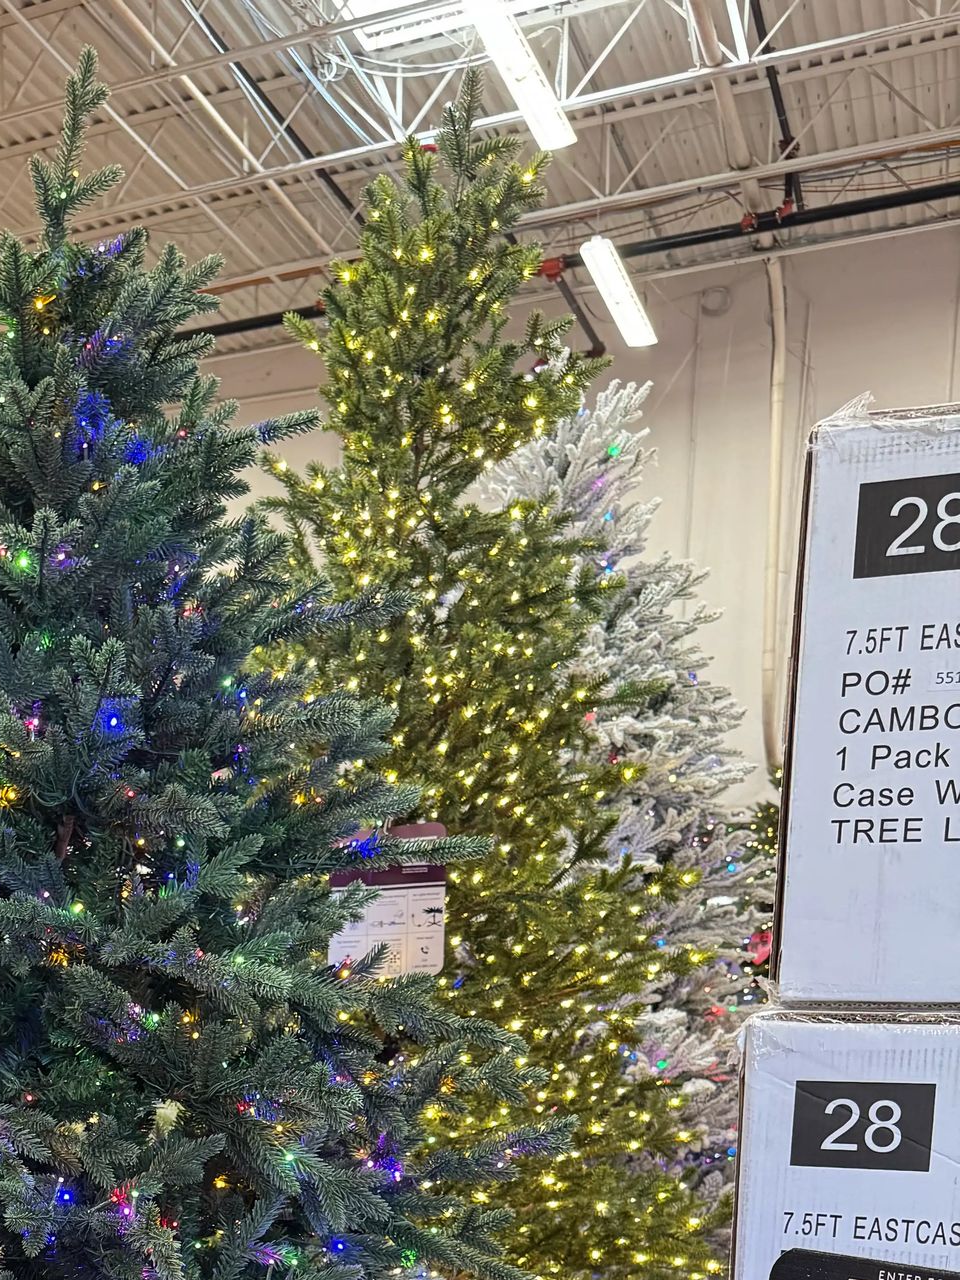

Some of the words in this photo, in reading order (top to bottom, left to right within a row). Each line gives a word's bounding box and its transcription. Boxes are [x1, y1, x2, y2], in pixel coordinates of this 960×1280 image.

[886, 492, 960, 557] 28
[846, 626, 908, 655] 7.5FT
[841, 668, 911, 697] PO#
[836, 746, 847, 771] 1
[870, 742, 950, 770] Pack
[833, 782, 914, 808] Case
[831, 817, 923, 844] TREE
[820, 1098, 902, 1153] 28
[783, 1211, 842, 1238] 7.5FT
